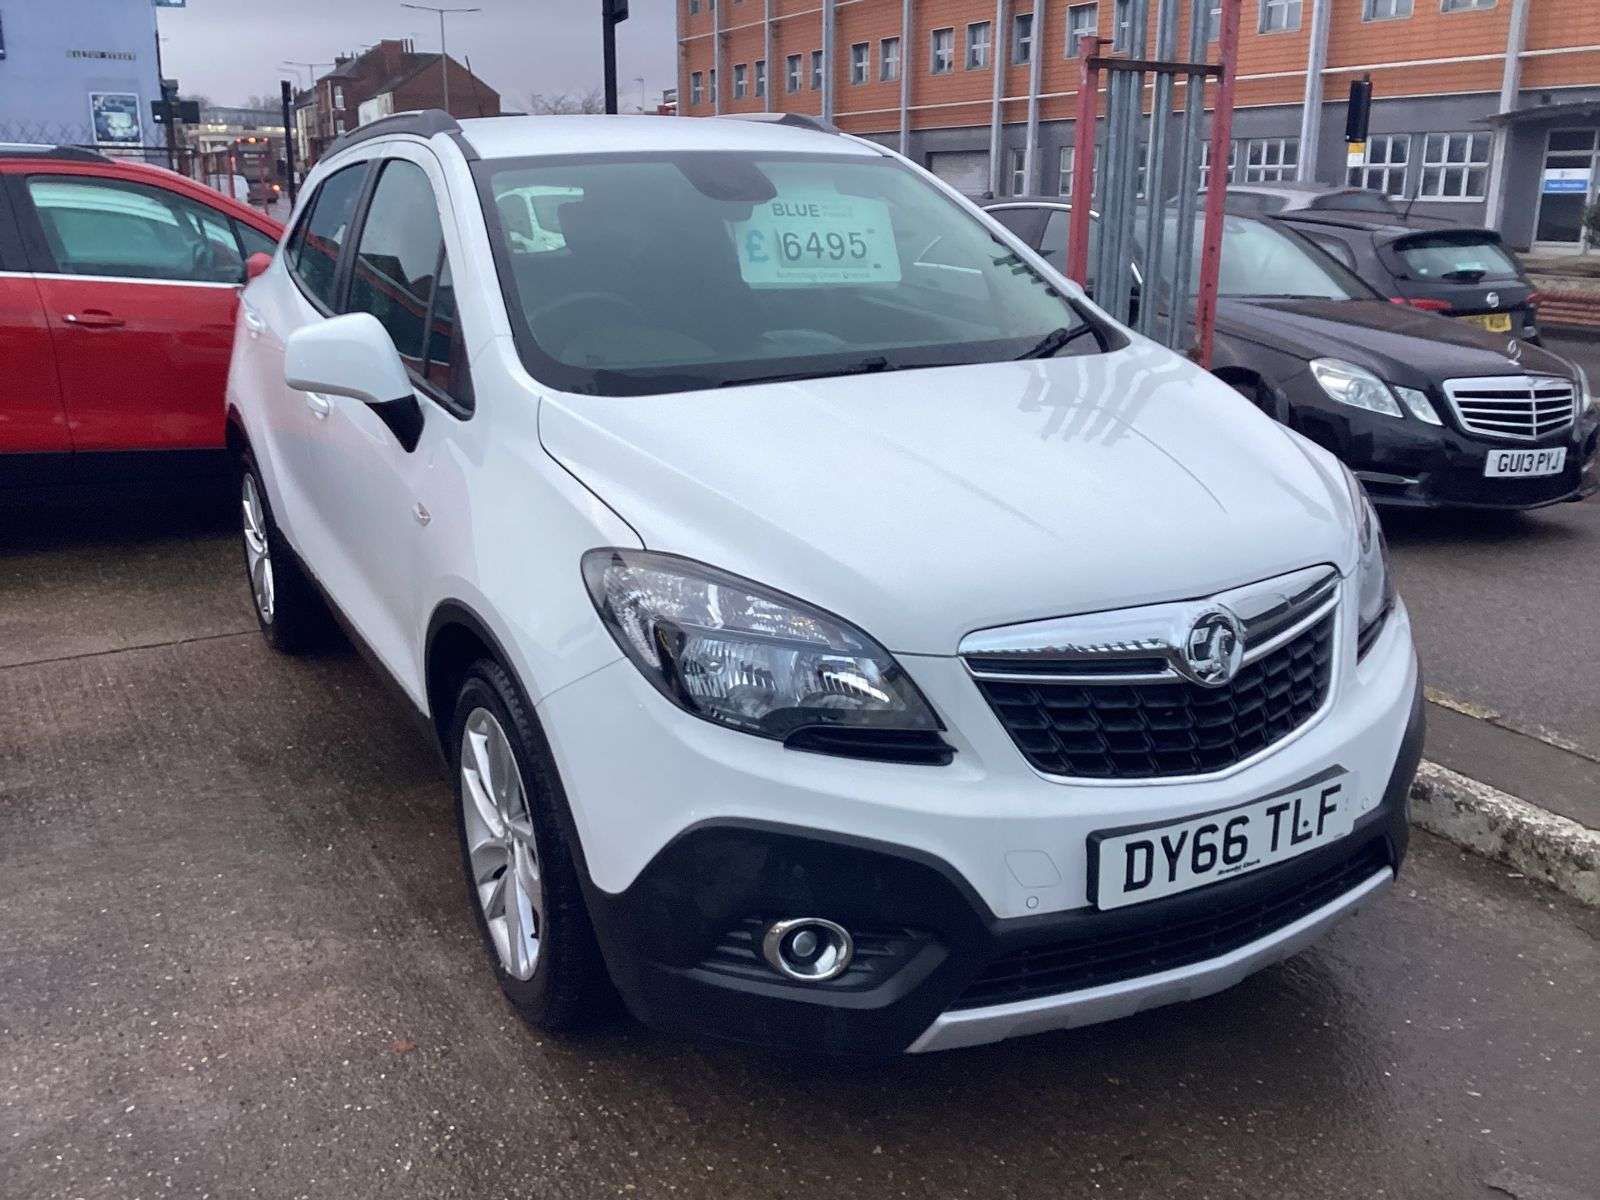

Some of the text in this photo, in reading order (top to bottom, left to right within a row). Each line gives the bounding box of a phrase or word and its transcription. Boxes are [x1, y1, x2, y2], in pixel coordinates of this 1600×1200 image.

[772, 202, 821, 218] BLUE
[782, 231, 868, 261] 6495
[1497, 451, 1561, 473] GU13 PYJ
[1123, 783, 1342, 893] DY66 TLF
